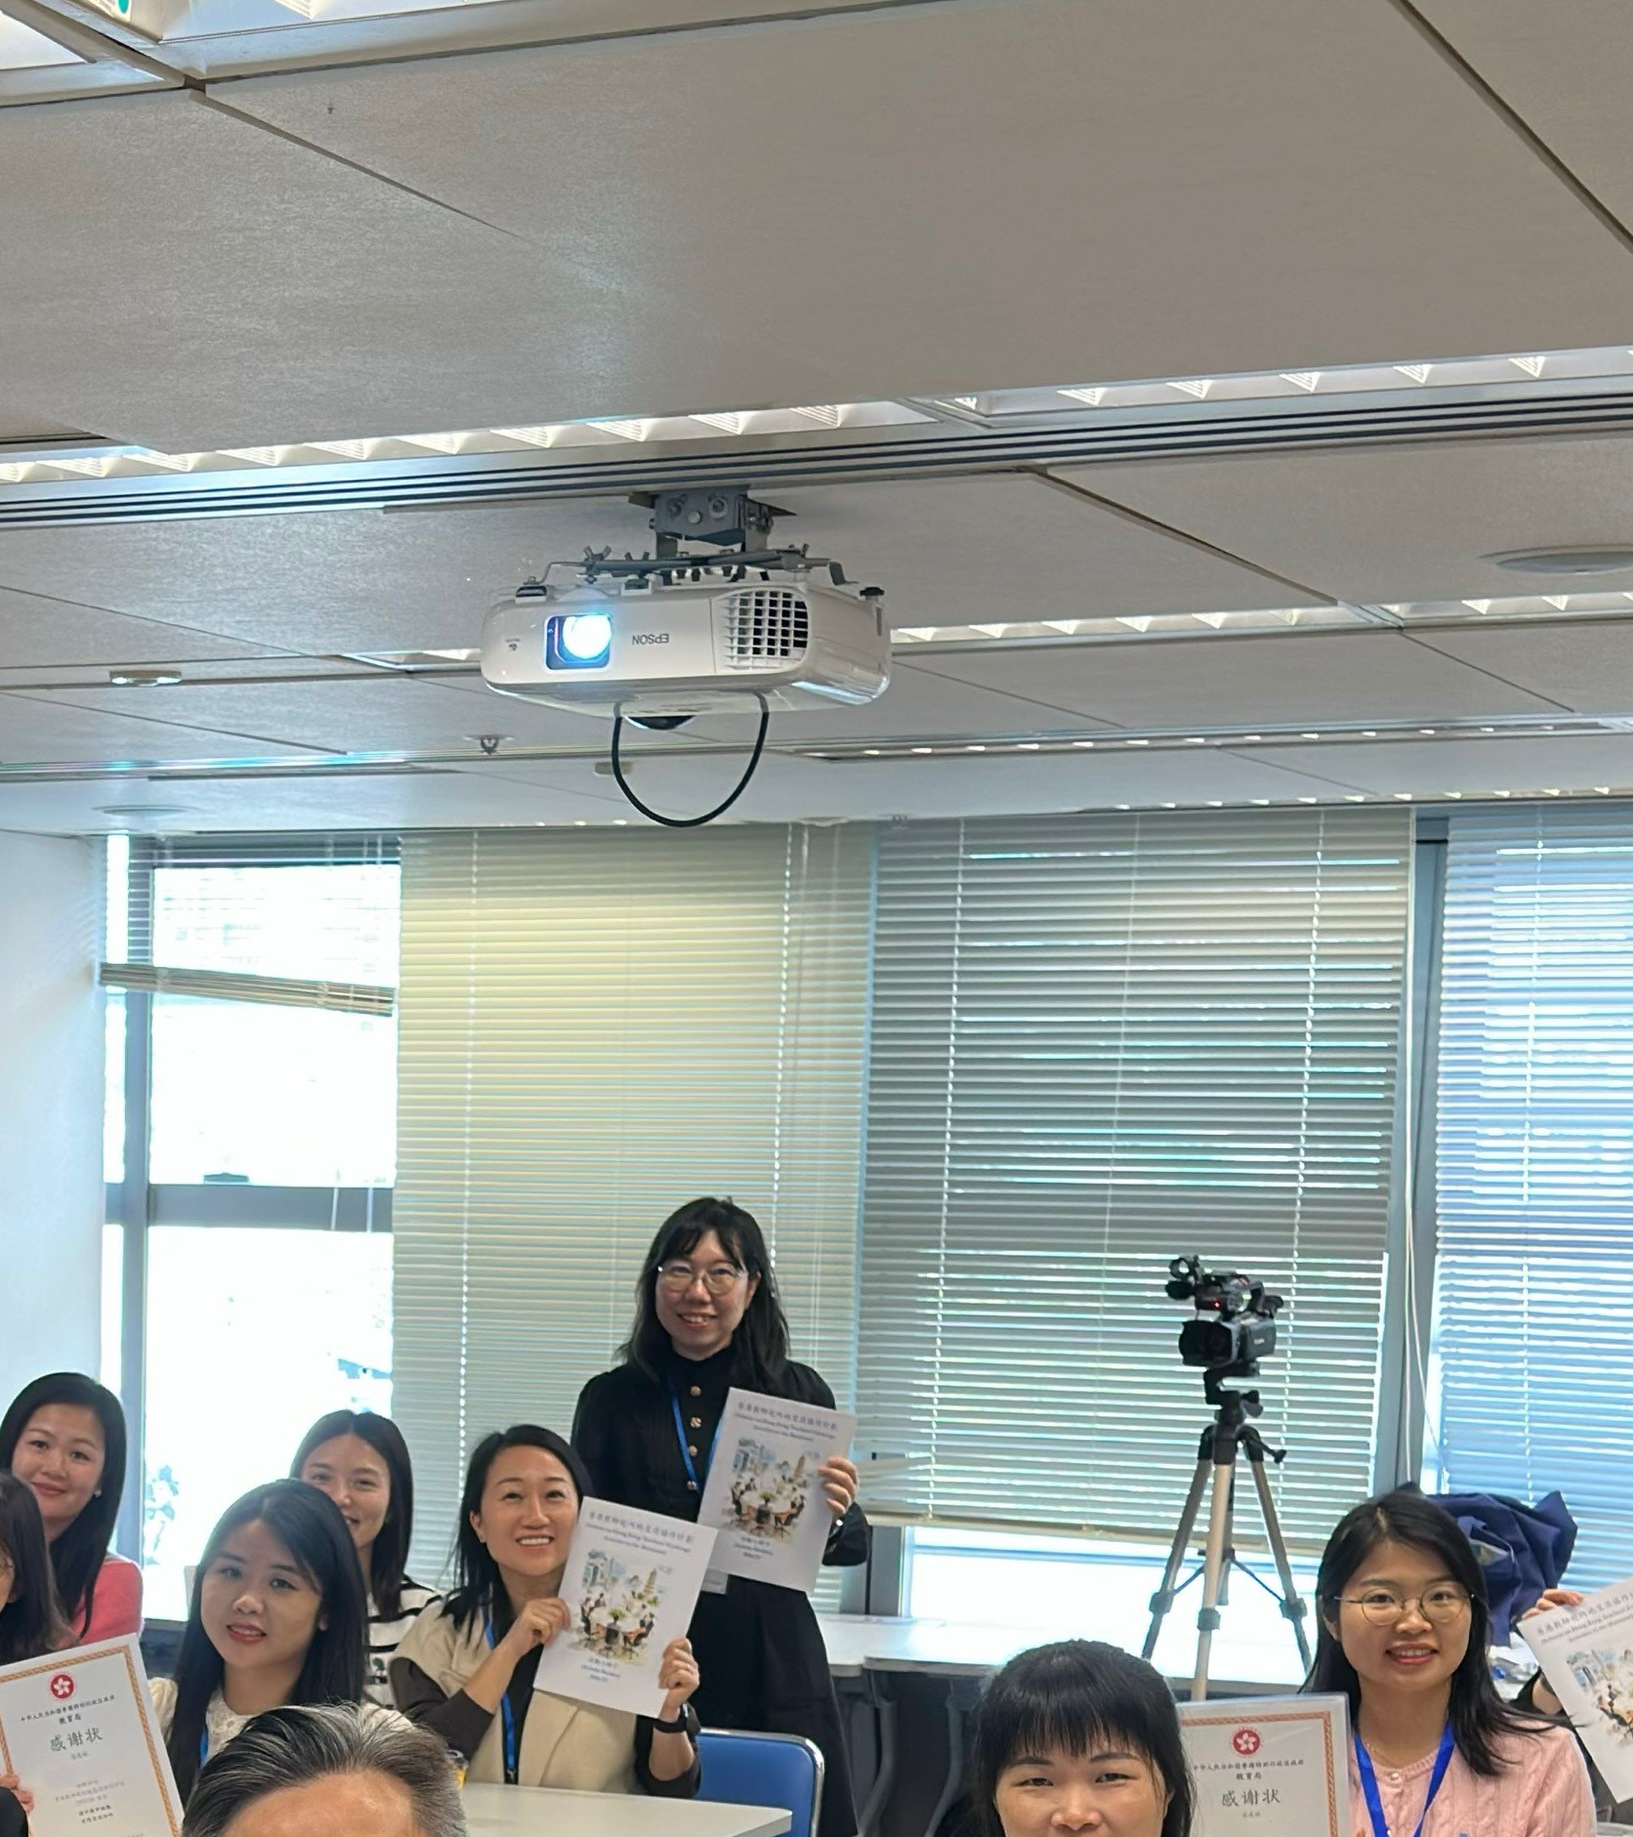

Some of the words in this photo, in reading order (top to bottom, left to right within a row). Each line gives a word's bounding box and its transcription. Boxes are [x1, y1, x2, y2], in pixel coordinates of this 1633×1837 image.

[632, 633, 670, 646] EPSON
[50, 1727, 103, 1752] 感谢状
[1221, 1788, 1281, 1807] 感谢状
